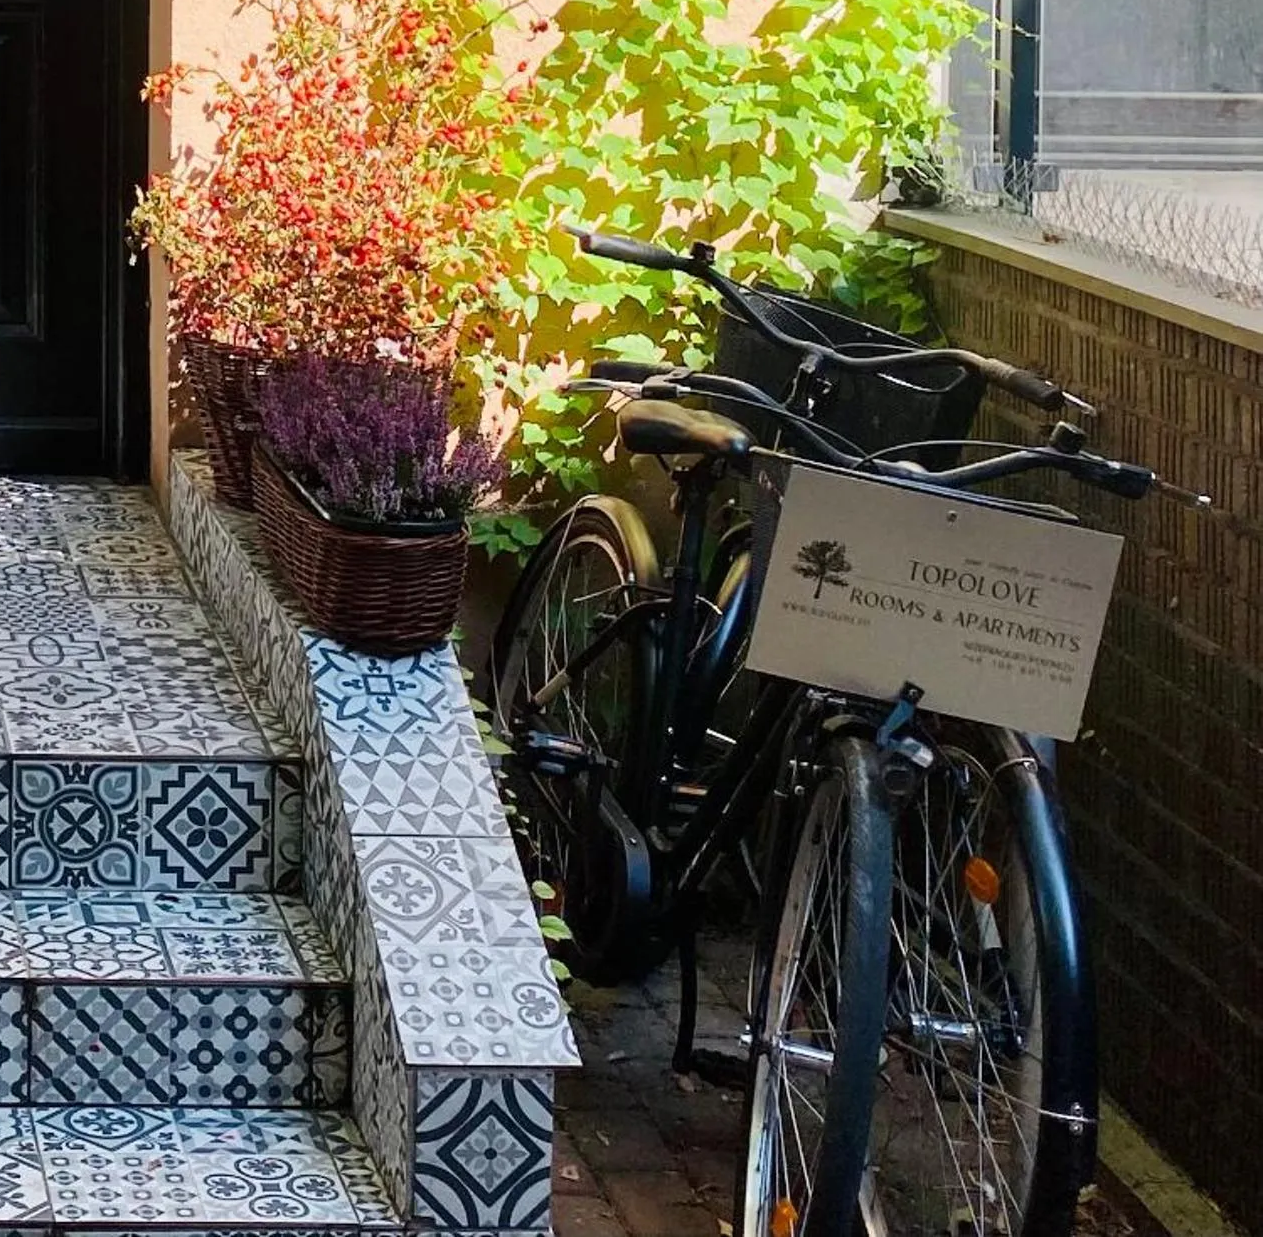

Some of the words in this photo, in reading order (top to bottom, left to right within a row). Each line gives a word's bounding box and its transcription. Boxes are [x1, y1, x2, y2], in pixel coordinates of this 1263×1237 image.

[908, 559, 1043, 609] TOPOLOVE
[849, 584, 925, 620] ROOMS
[931, 610, 946, 624] &
[952, 609, 1082, 653] APARTMENTS
